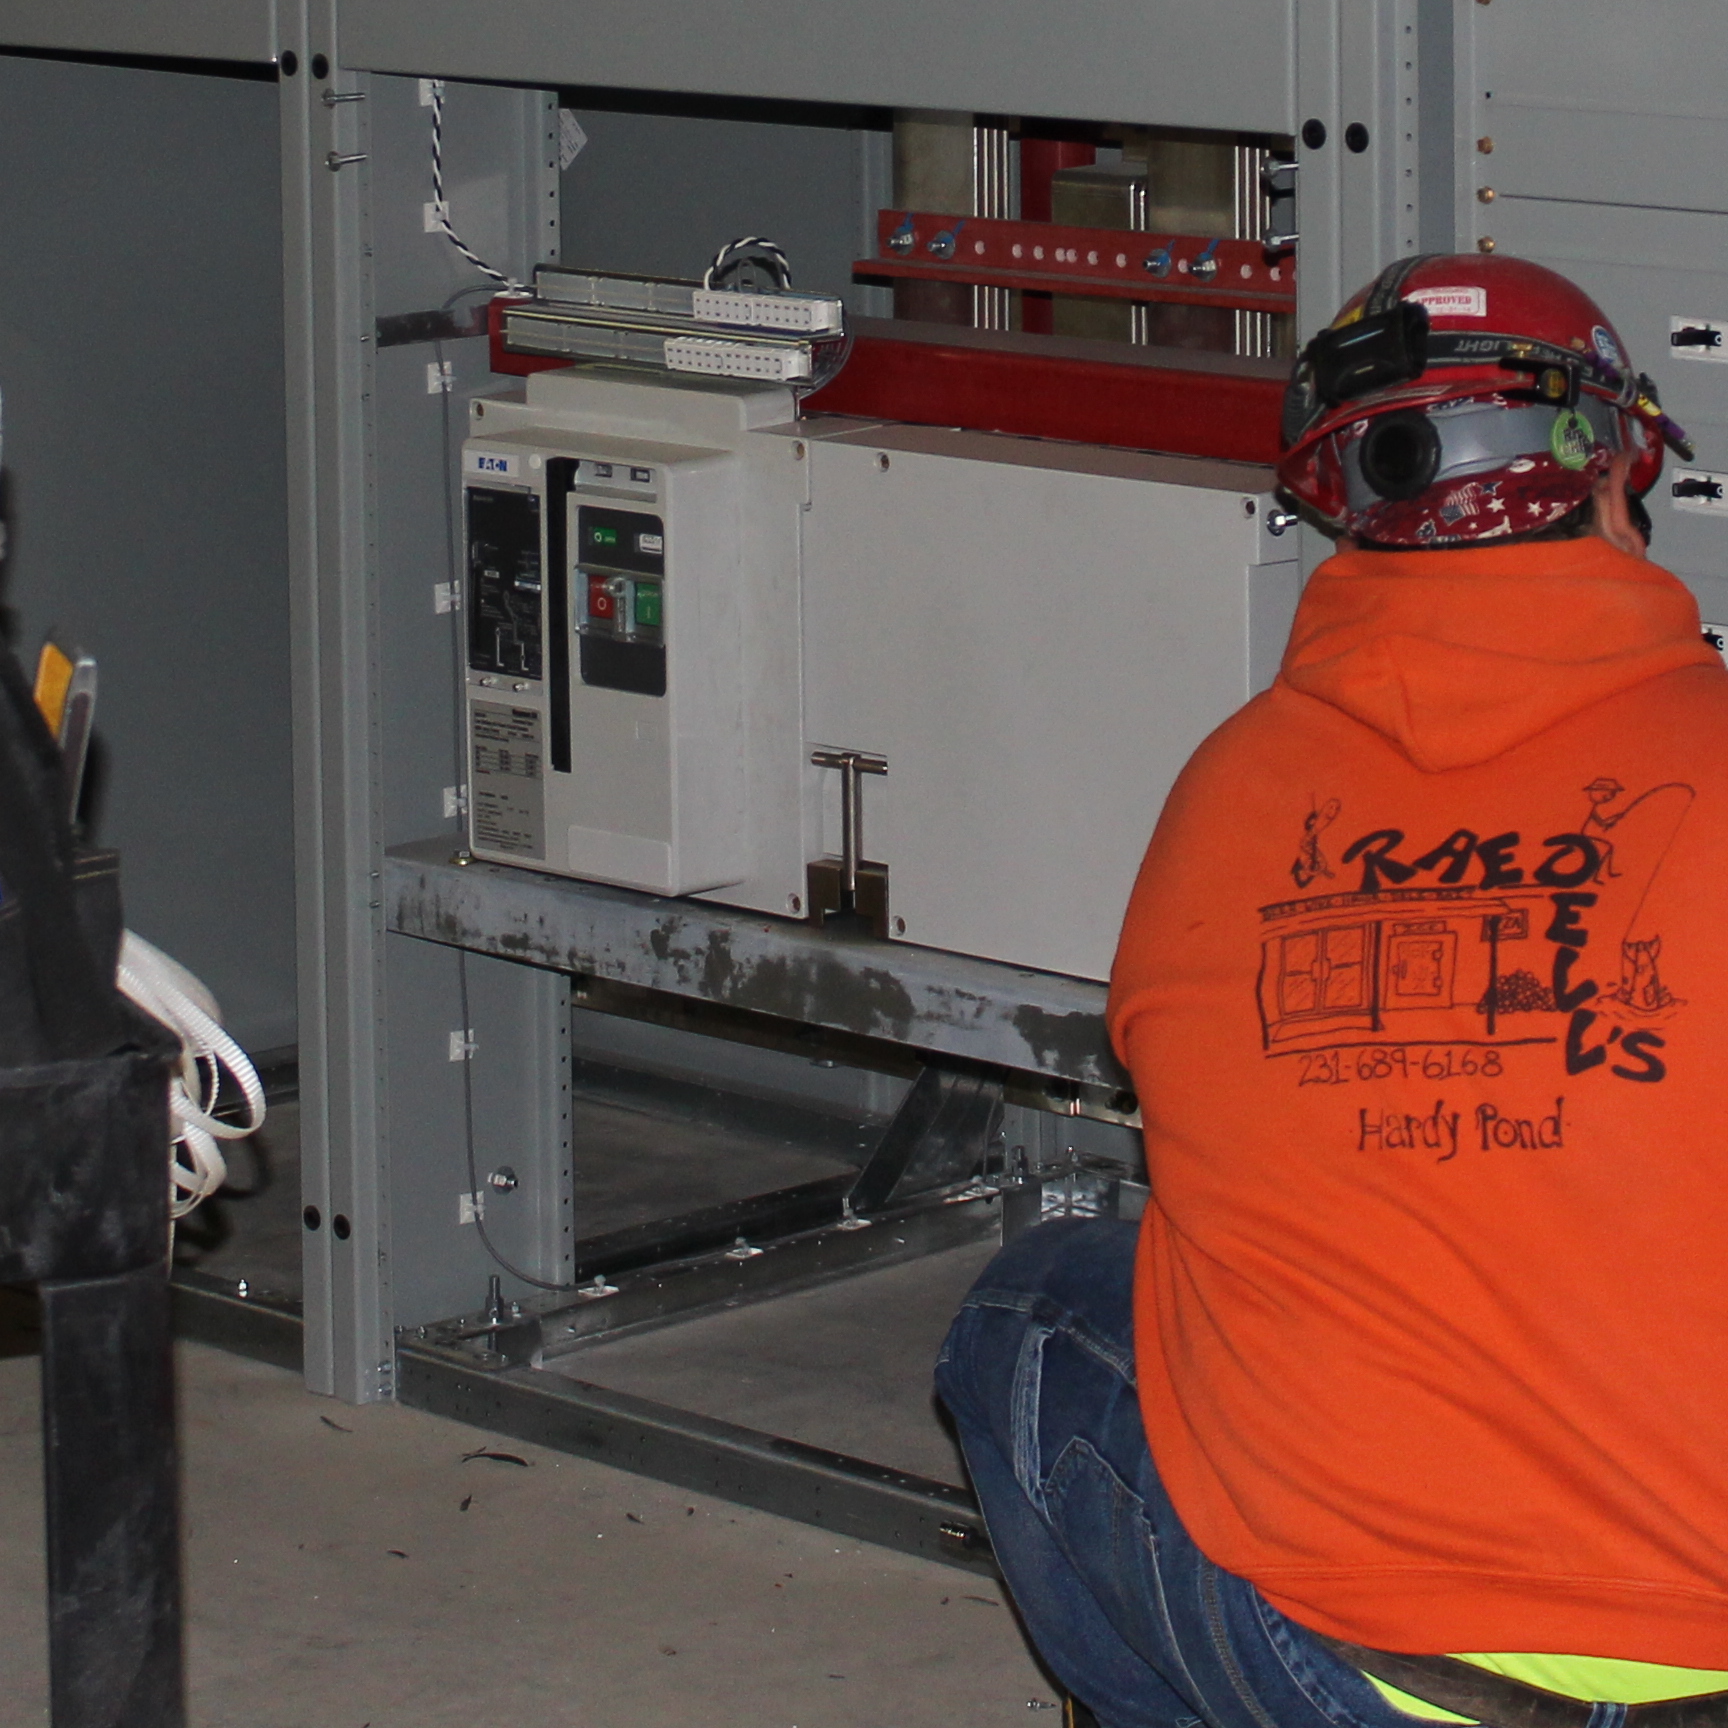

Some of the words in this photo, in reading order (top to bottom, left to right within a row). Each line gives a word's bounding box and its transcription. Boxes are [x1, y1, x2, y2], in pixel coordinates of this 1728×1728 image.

[1298, 1047, 1504, 1088] 231-689-6168
[1358, 1099, 1460, 1164] Hardy
[1475, 1095, 1565, 1152] Pond
